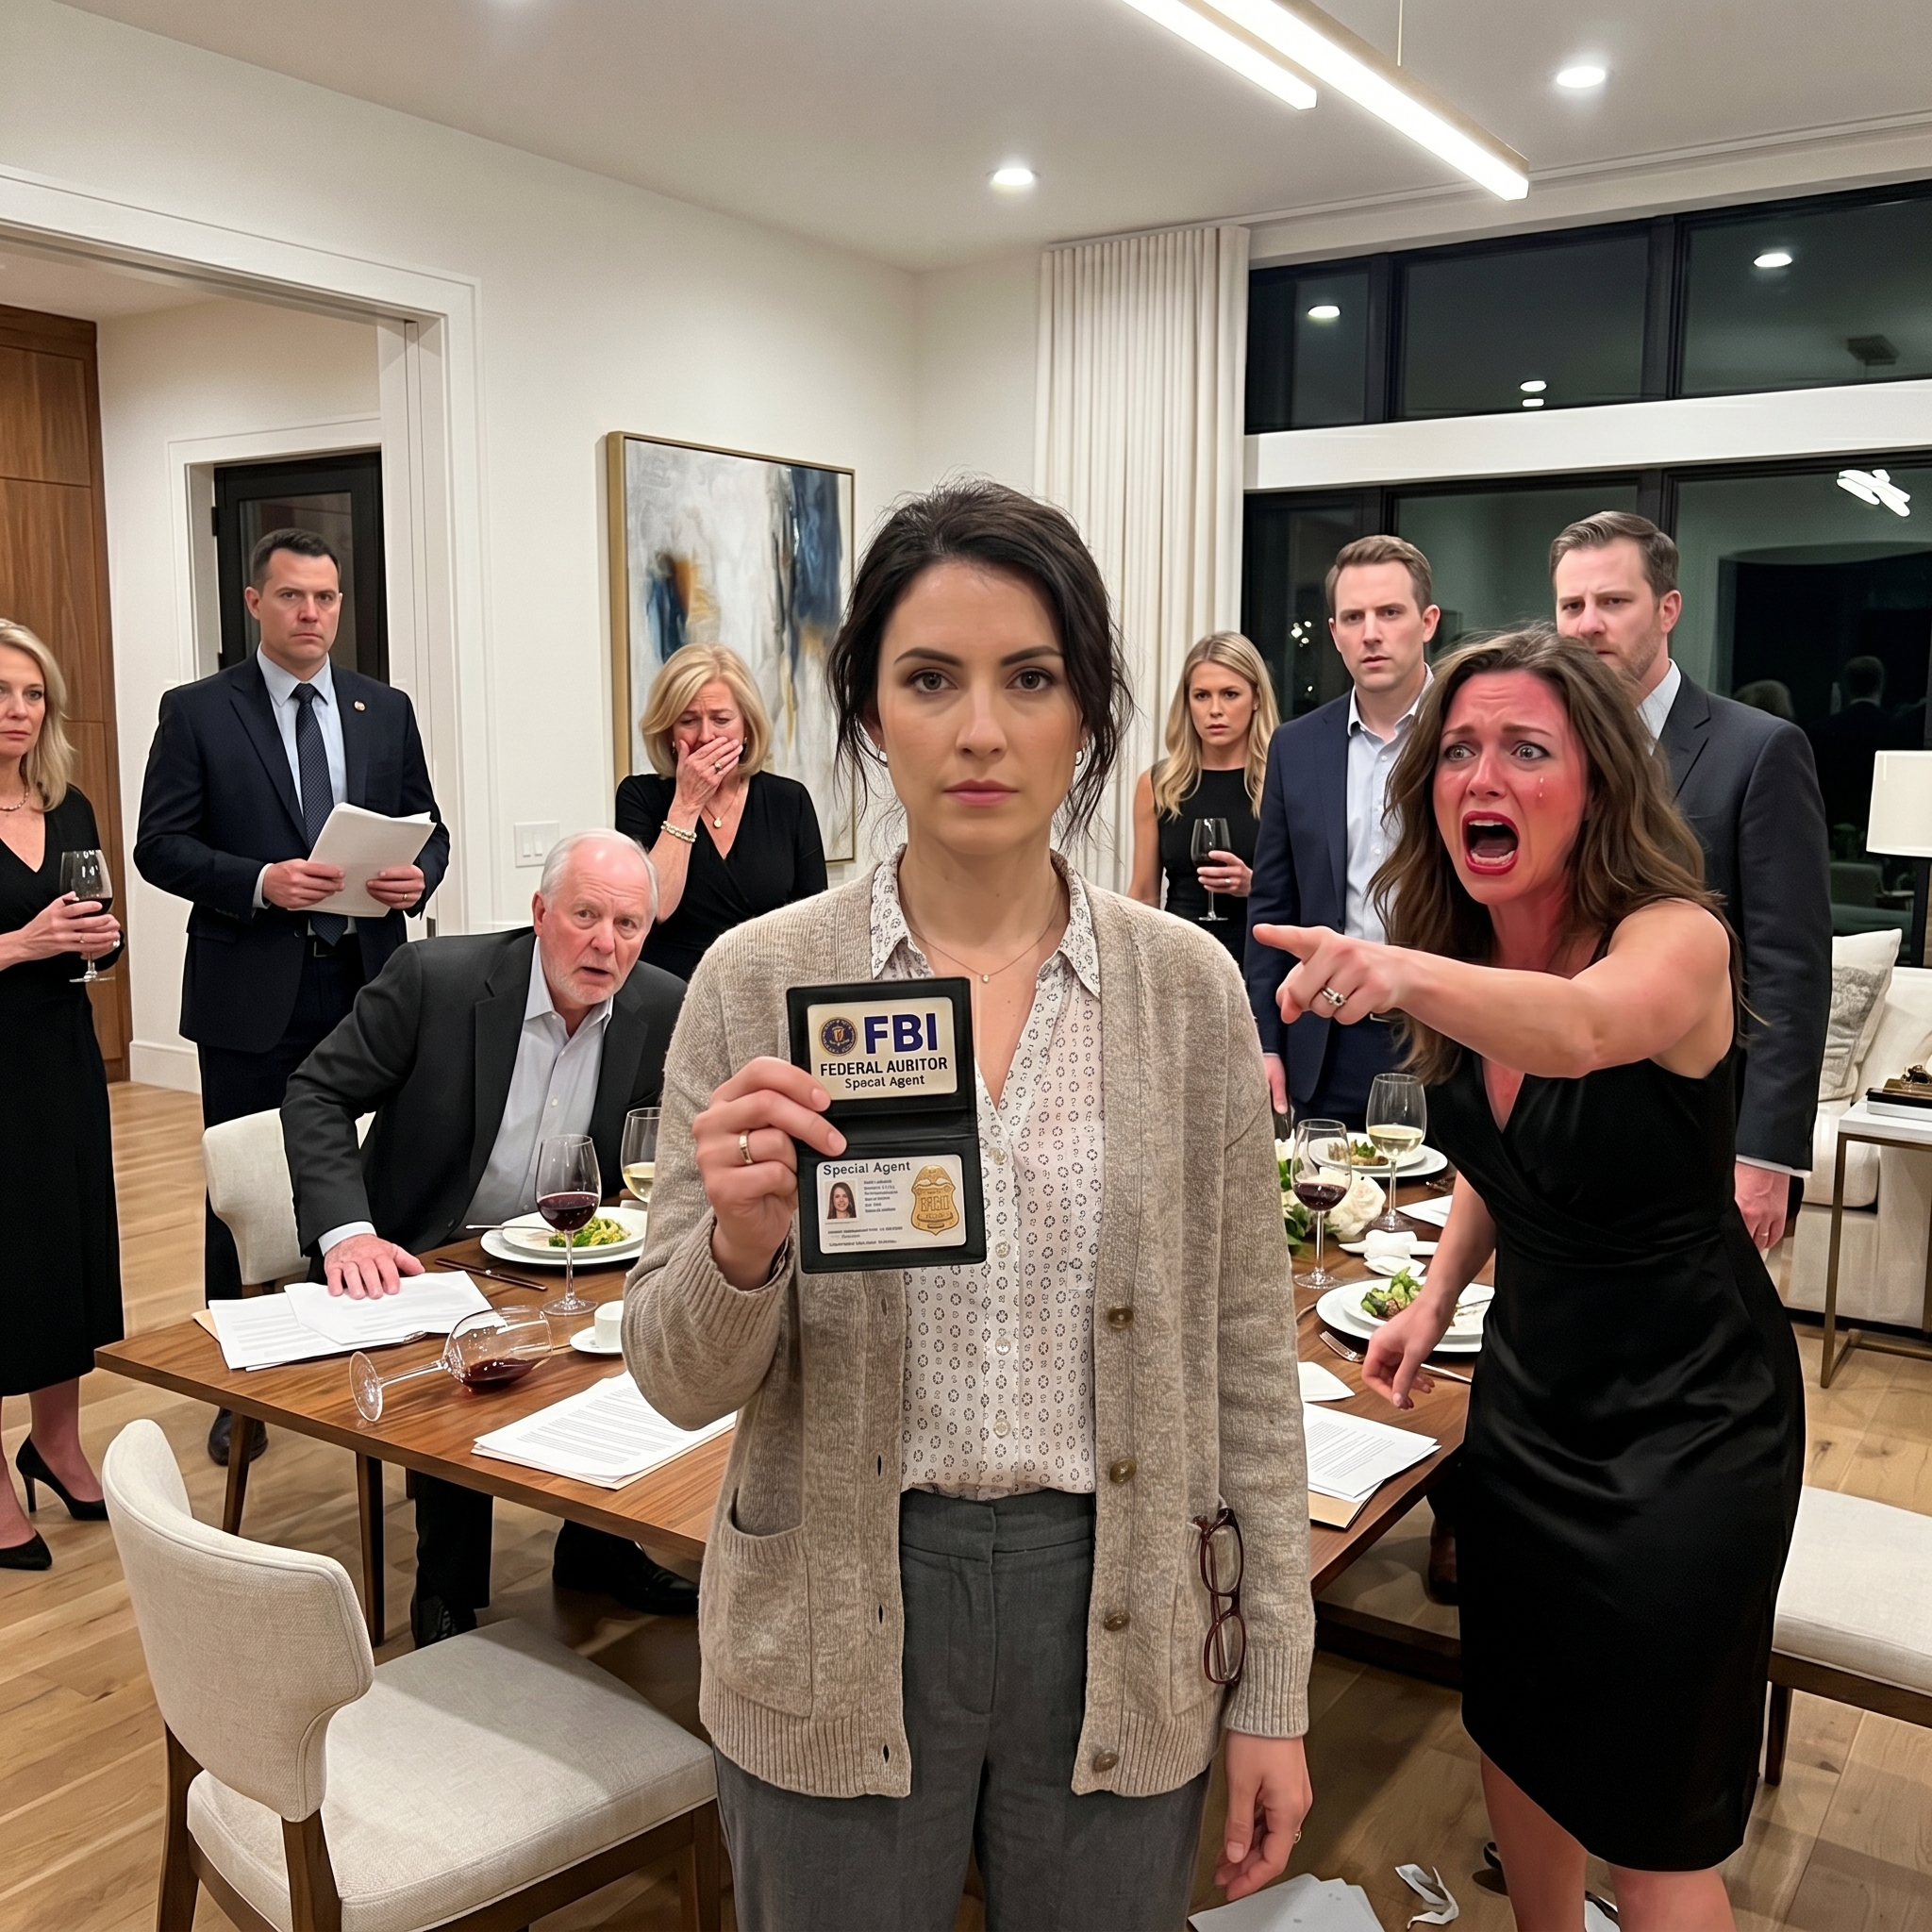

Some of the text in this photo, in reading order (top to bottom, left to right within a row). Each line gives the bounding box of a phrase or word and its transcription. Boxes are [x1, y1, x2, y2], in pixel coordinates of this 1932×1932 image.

[864, 1013, 938, 1054] FBI
[820, 1060, 883, 1076] FEDERAL
[890, 1074, 925, 1089] Agent
[824, 1161, 911, 1178] Special Agent
